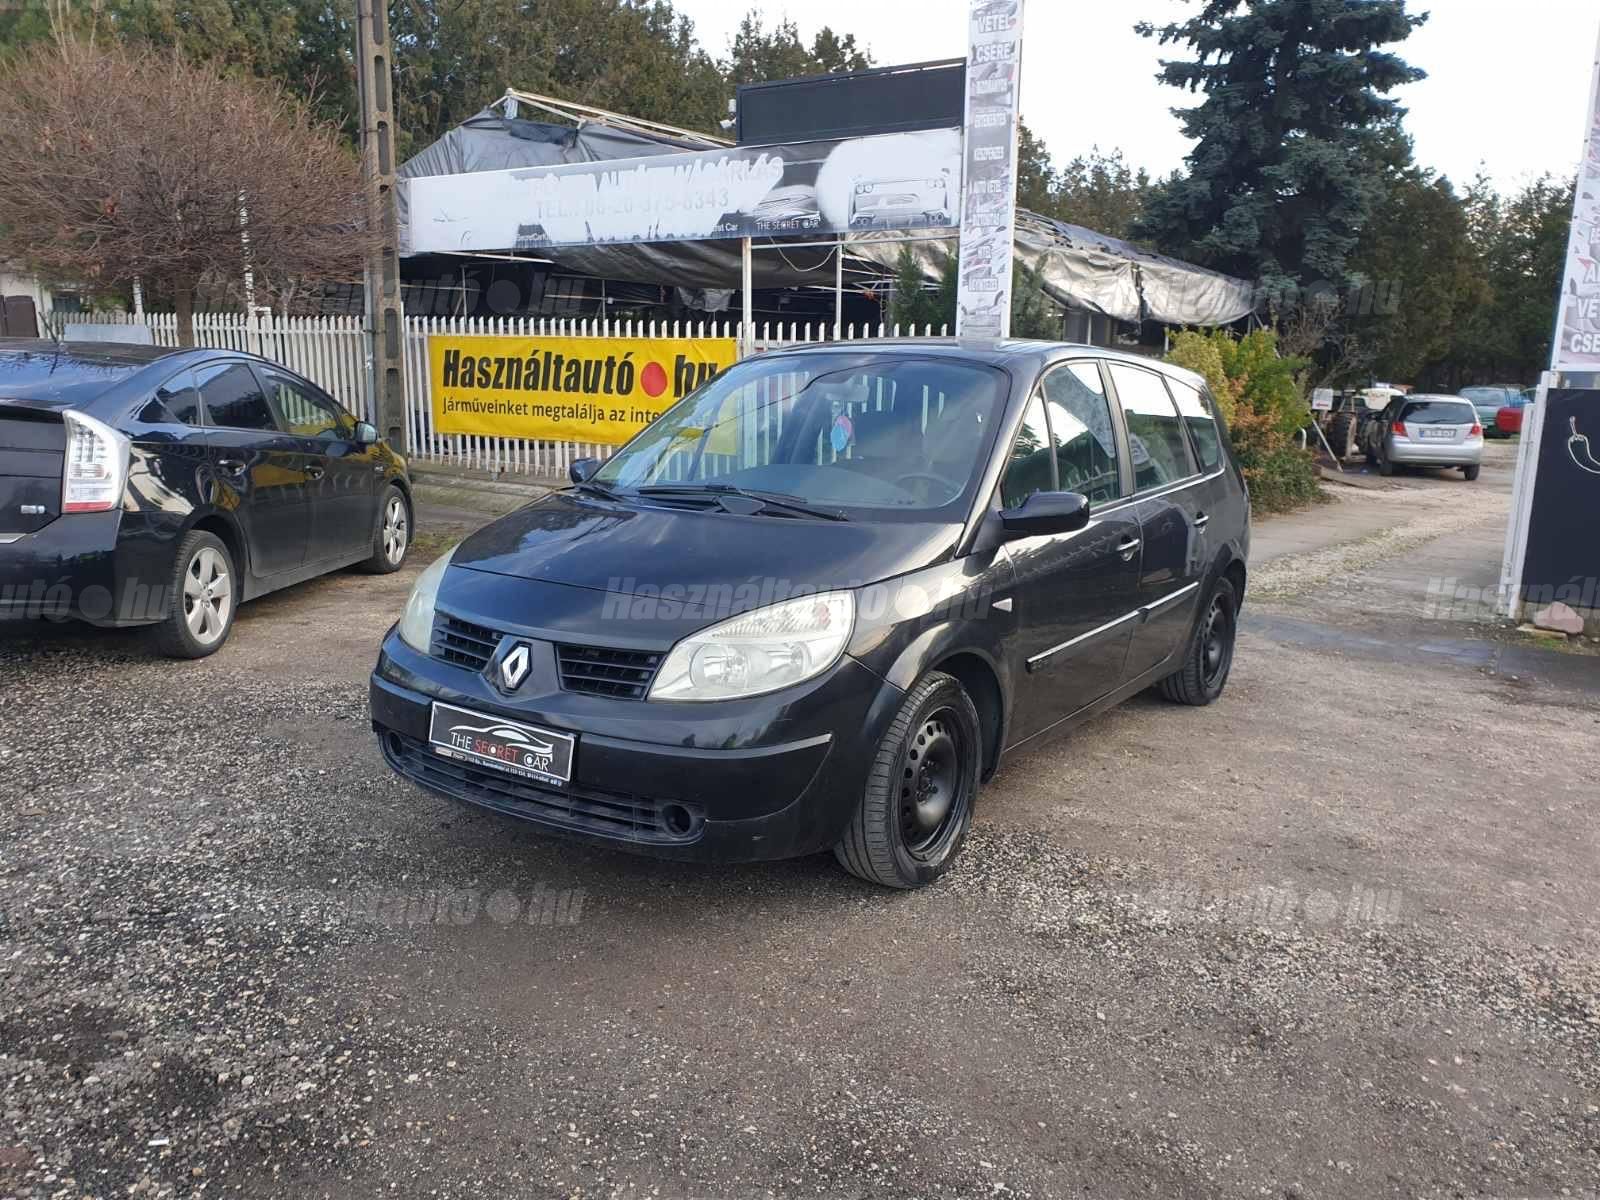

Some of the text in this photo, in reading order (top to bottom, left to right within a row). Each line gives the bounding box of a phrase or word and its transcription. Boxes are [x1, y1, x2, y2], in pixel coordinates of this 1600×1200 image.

[976, 43, 1011, 63] CSERE
[443, 349, 634, 396] Használtautó
[442, 396, 529, 416] Járműveinket
[532, 402, 605, 424] megtalálja
[609, 409, 626, 422] az
[450, 731, 473, 750] THE
[475, 739, 519, 762] SECRET
[523, 753, 550, 772] CAR
